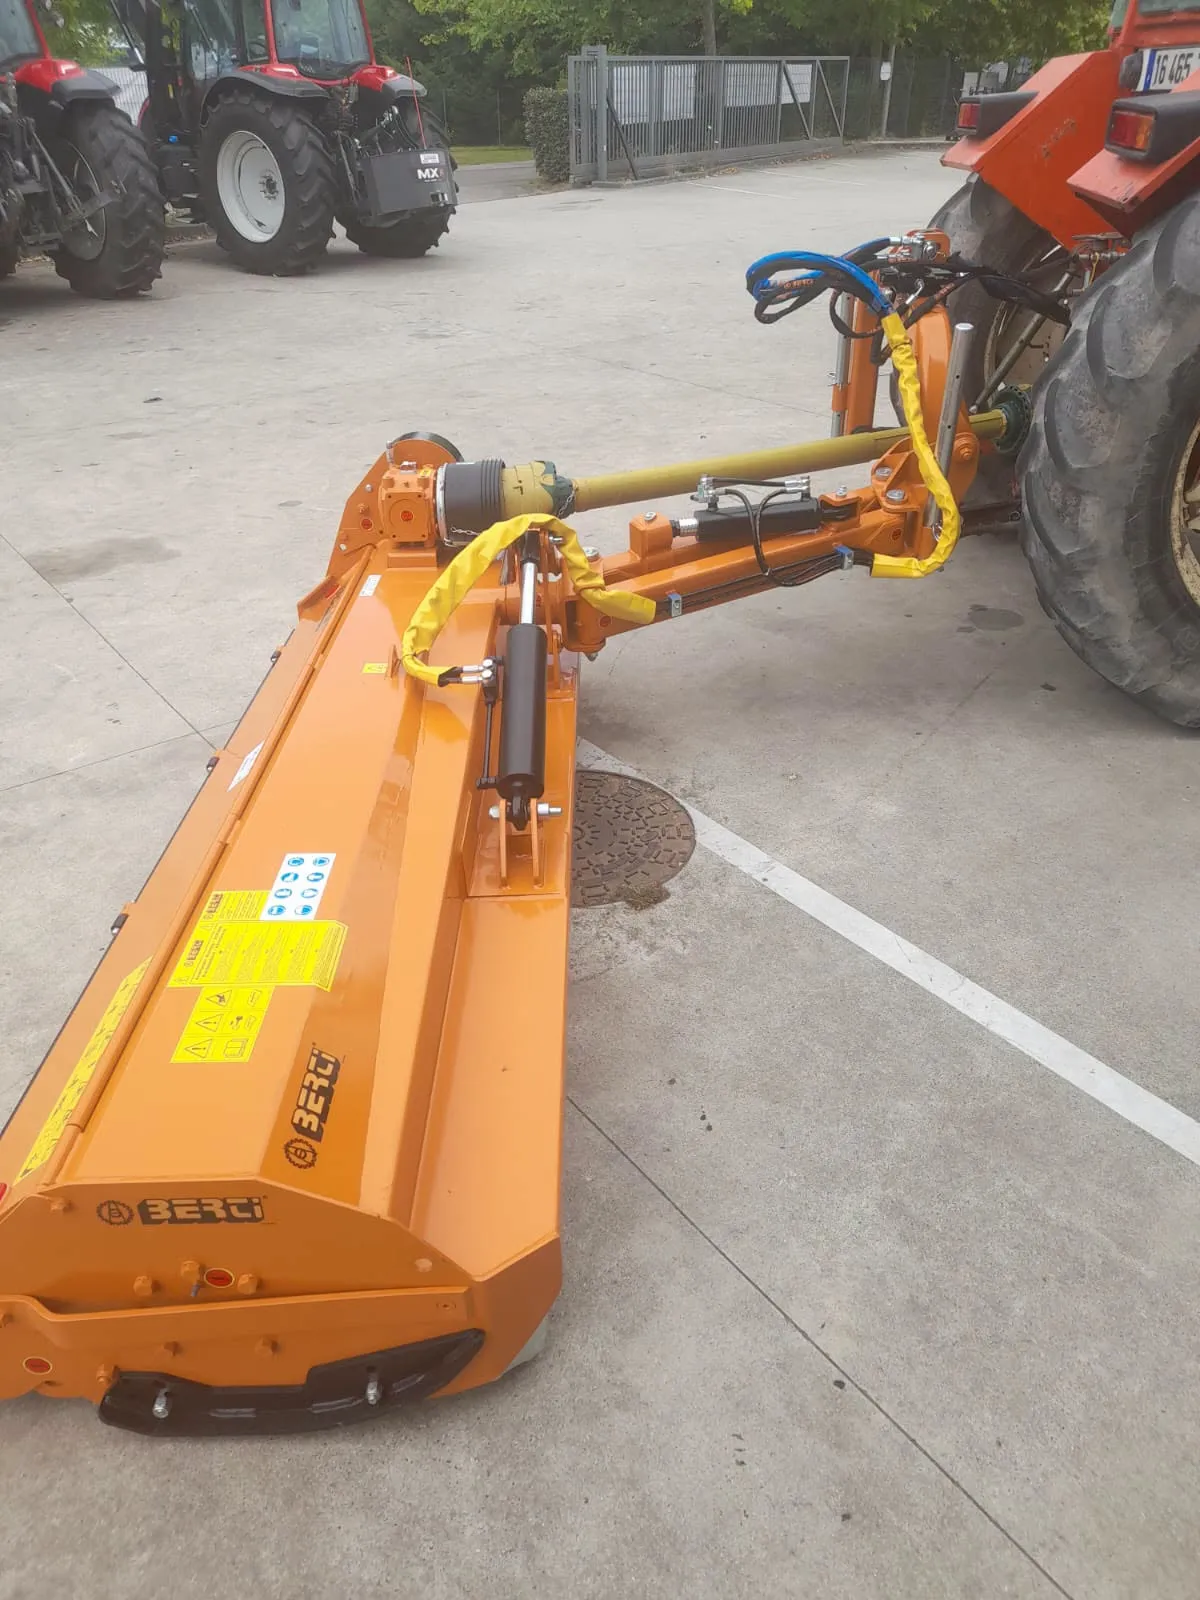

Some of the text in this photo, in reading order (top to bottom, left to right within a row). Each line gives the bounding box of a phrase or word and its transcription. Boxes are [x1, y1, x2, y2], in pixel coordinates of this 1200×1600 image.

[1153, 53, 1194, 86] 16 465
[417, 167, 439, 179] MX
